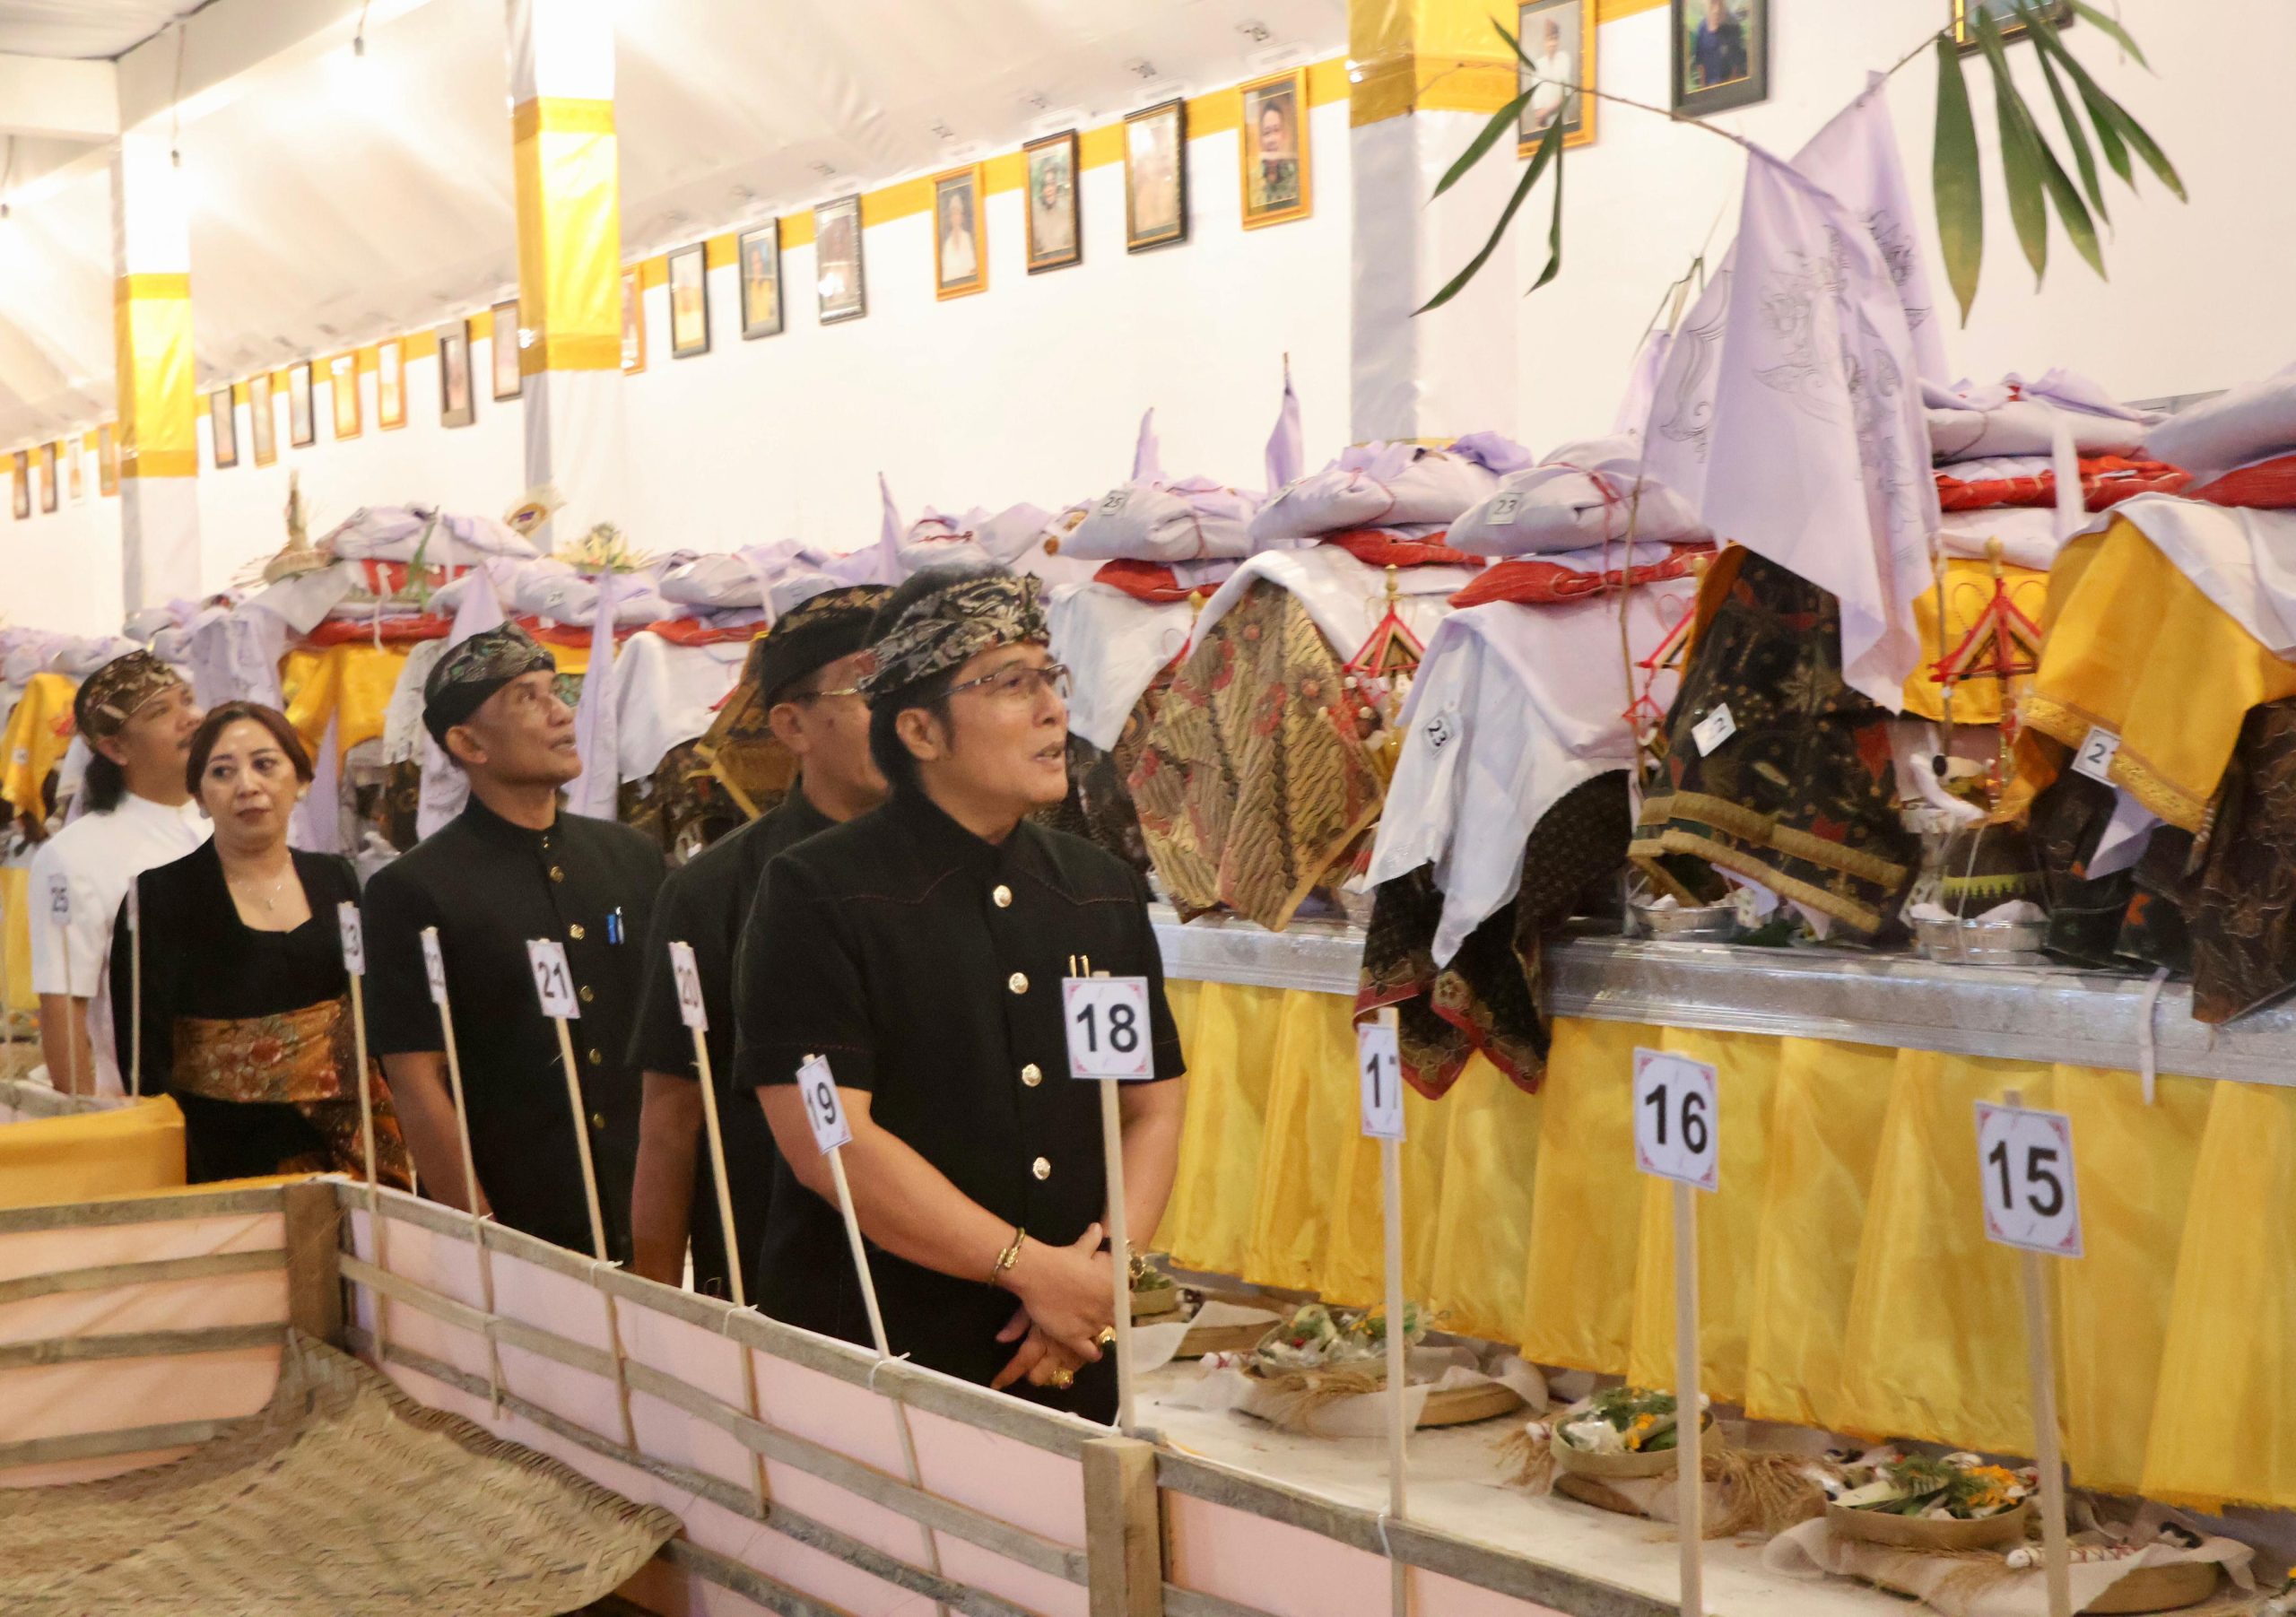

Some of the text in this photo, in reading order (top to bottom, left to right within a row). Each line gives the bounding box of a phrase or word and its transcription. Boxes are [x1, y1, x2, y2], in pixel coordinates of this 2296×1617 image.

[1103, 496, 1124, 508] 25
[1493, 499, 1518, 515] 23
[1428, 719, 1448, 746] 23
[538, 961, 568, 999] 21
[1076, 1003, 1138, 1053] 18
[807, 1082, 836, 1132] 19
[1645, 1083, 1708, 1155] 16
[1988, 1139, 2064, 1218] 15
